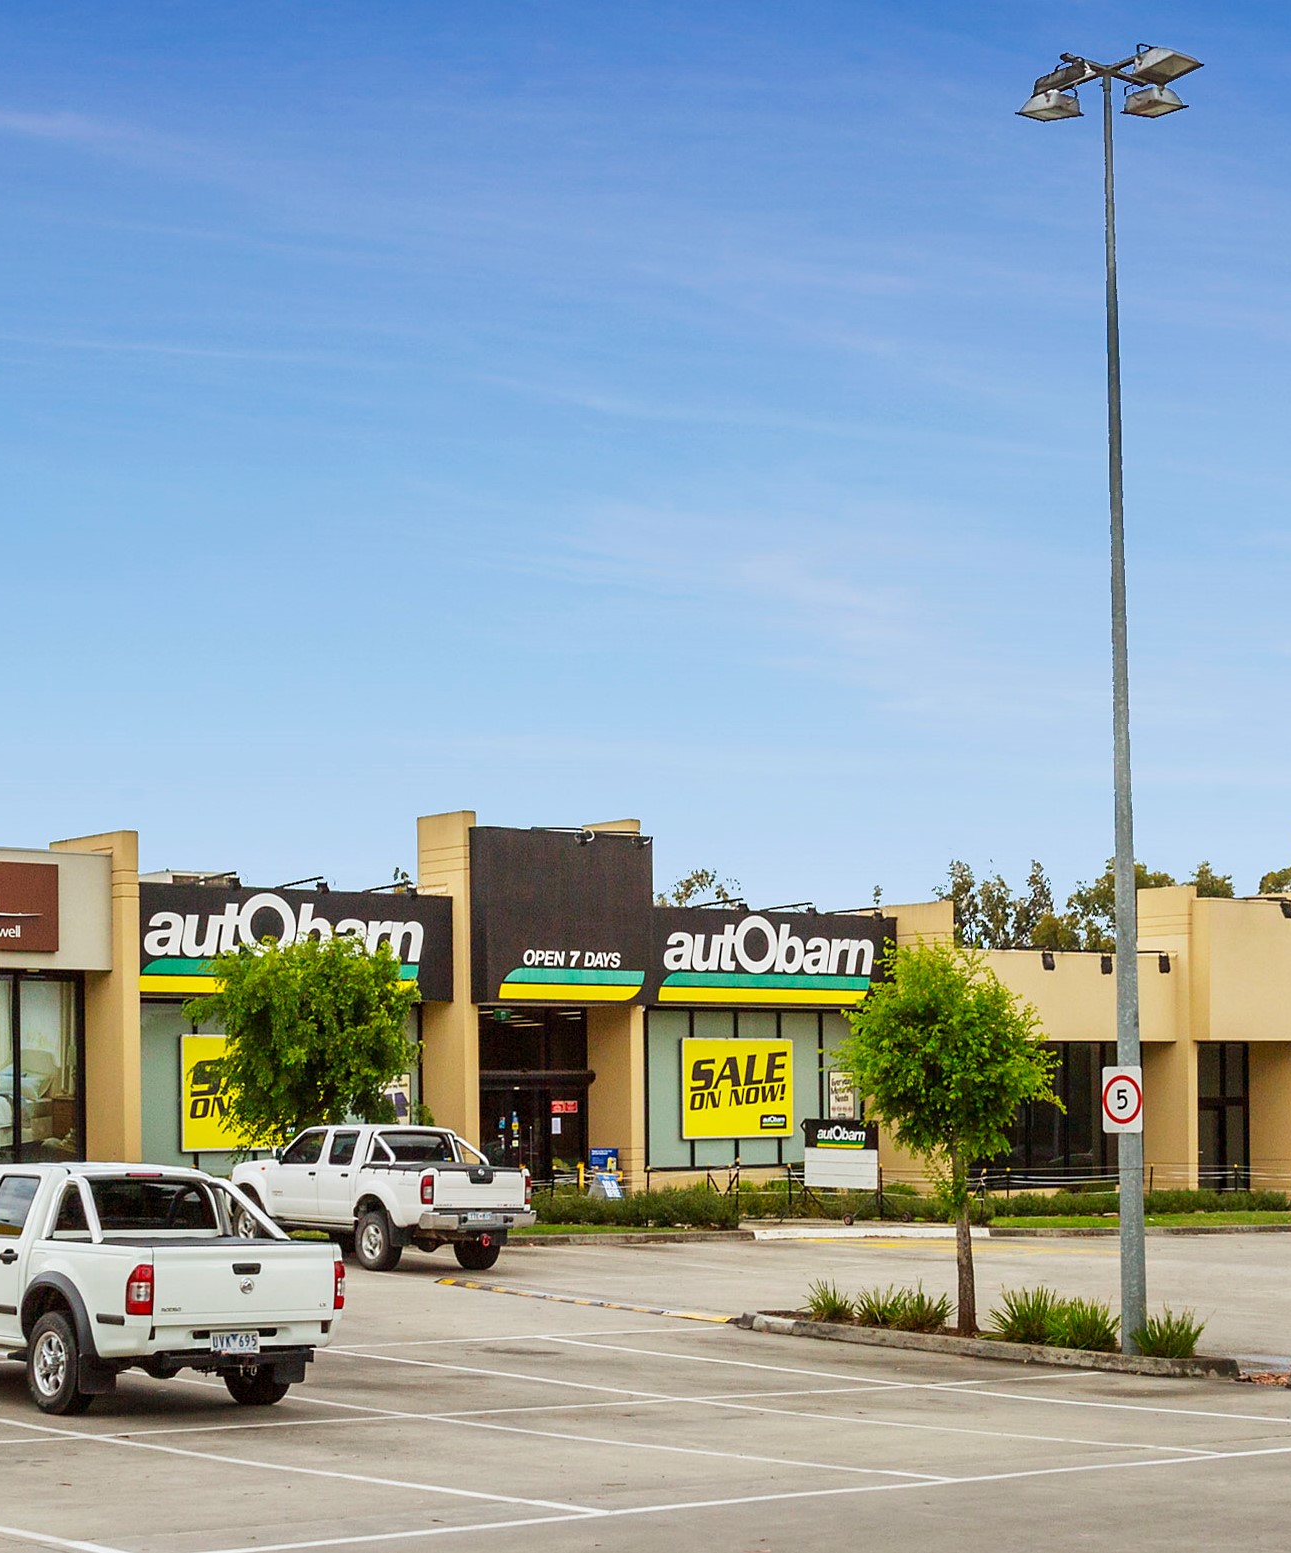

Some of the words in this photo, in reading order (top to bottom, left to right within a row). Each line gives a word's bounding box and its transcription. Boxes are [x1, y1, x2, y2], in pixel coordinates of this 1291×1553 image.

[663, 915, 875, 975] autObarn
[523, 949, 565, 967] OPEN
[569, 950, 581, 967] 7
[583, 951, 621, 968] DAYS
[690, 1051, 787, 1092] SALE
[690, 1091, 721, 1111] ON
[729, 1084, 786, 1107] NOW!
[1117, 1089, 1128, 1110] 5
[817, 1125, 866, 1142] autObarn
[212, 1335, 232, 1348] UVK
[238, 1334, 258, 1348] 695
